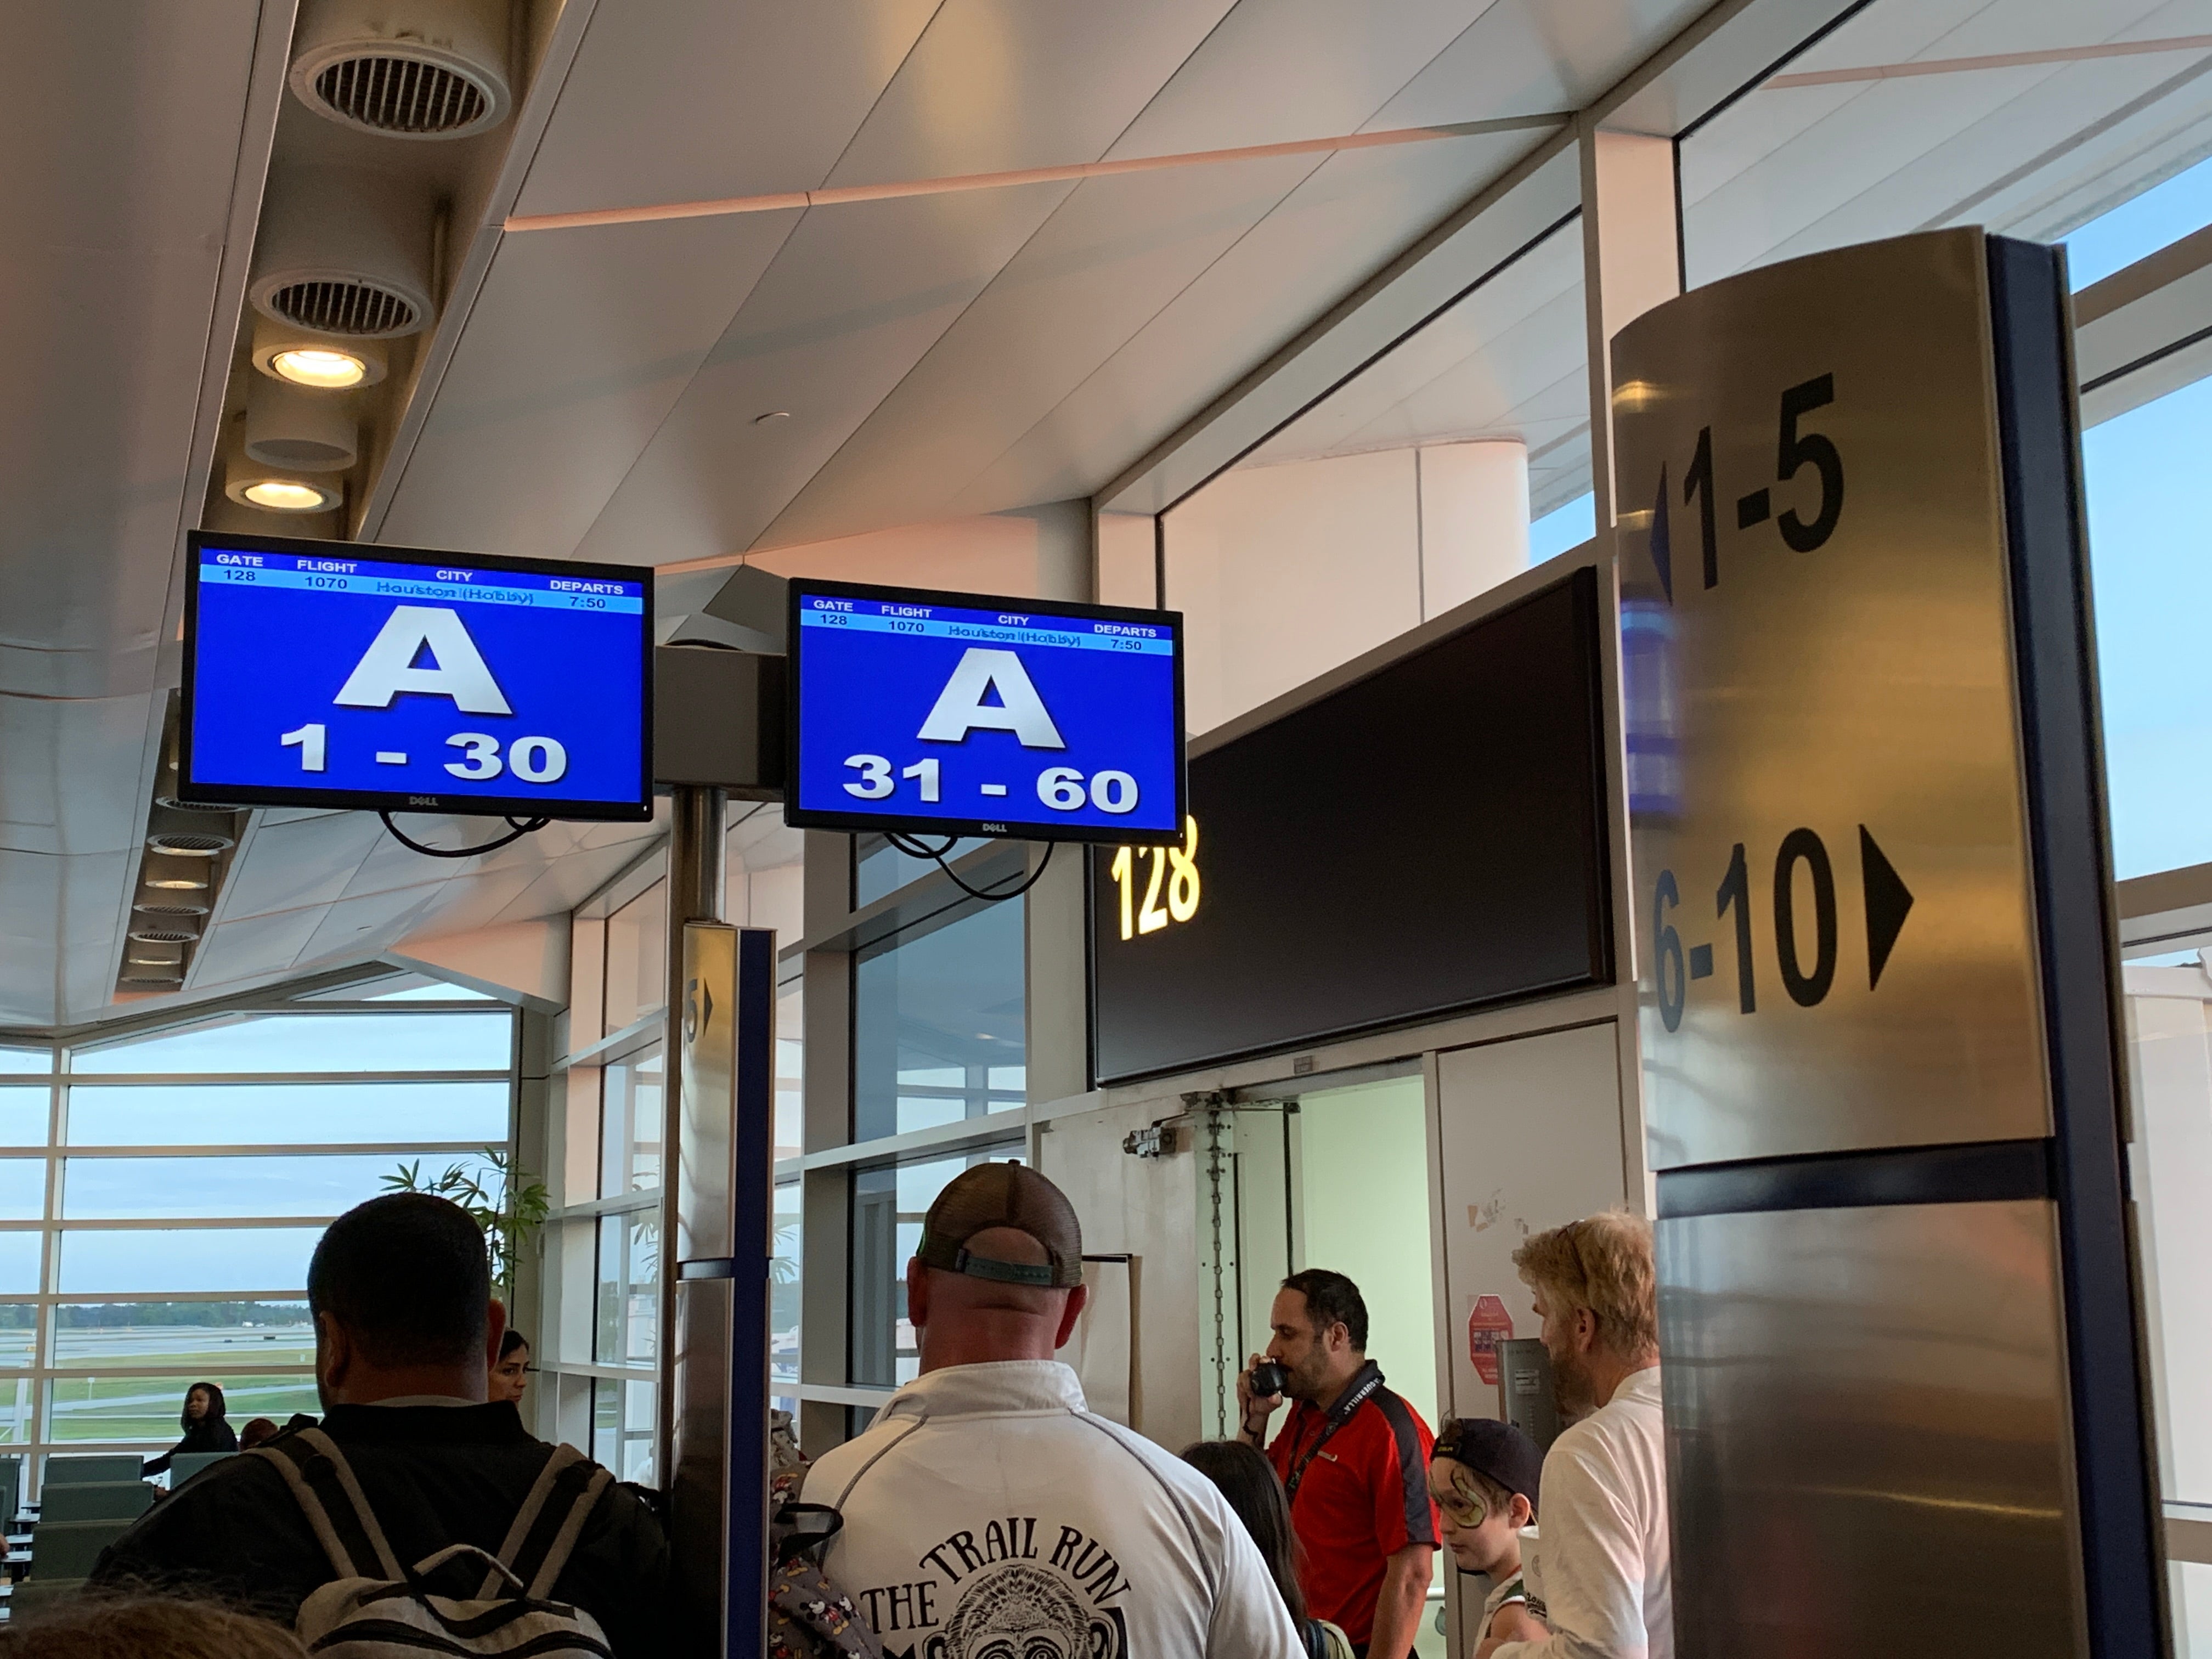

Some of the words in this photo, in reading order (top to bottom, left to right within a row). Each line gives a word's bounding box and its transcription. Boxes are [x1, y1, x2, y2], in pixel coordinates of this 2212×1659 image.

[1683, 372, 1844, 591] 1-5
[216, 554, 263, 567] GATE
[297, 560, 357, 573] FLIGHT
[436, 570, 473, 582] CITY
[550, 579, 624, 595] DEPARTS
[223, 569, 256, 582] 128
[304, 576, 347, 589] 1070
[376, 582, 455, 597] Houston
[569, 596, 606, 609] 7:50
[813, 600, 854, 612] GATE
[881, 605, 932, 618] FLIGHT
[998, 614, 1029, 626] CITY
[1094, 624, 1157, 638] DEPARTS
[820, 614, 848, 625] 128
[888, 620, 924, 633] 1070
[948, 625, 1015, 641] Houston
[1110, 639, 1142, 651] 7:50
[332, 605, 513, 715] A
[917, 647, 1066, 749] A
[280, 723, 326, 772] 1
[443, 732, 568, 783] 30
[409, 796, 438, 806] DELL
[843, 754, 940, 803] 31
[1036, 767, 1139, 814] 60
[982, 823, 1007, 832] DELL
[1111, 815, 1200, 940] 128
[1654, 827, 1837, 1034] 6-10
[919, 1517, 1038, 1585] TRAIL
[1048, 1525, 1132, 1605] RUN
[859, 1580, 940, 1635] THE
